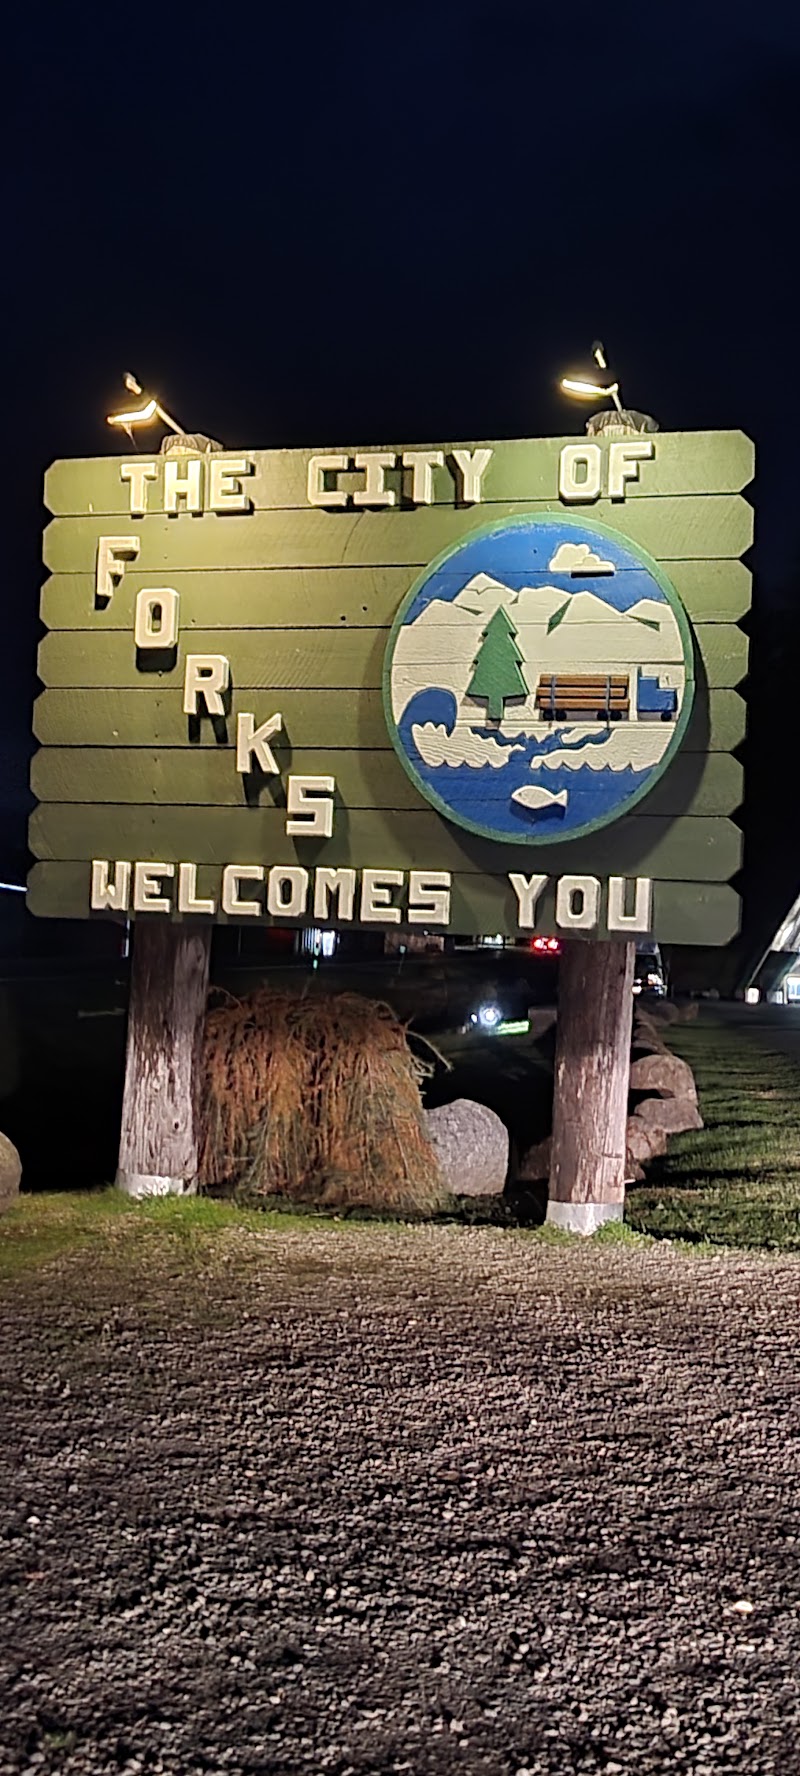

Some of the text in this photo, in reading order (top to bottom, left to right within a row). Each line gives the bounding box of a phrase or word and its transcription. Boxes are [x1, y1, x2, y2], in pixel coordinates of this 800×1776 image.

[120, 440, 653, 513] THE CITY OF
[95, 535, 336, 839] FORKS
[90, 859, 654, 933] WELCOMES YOU
